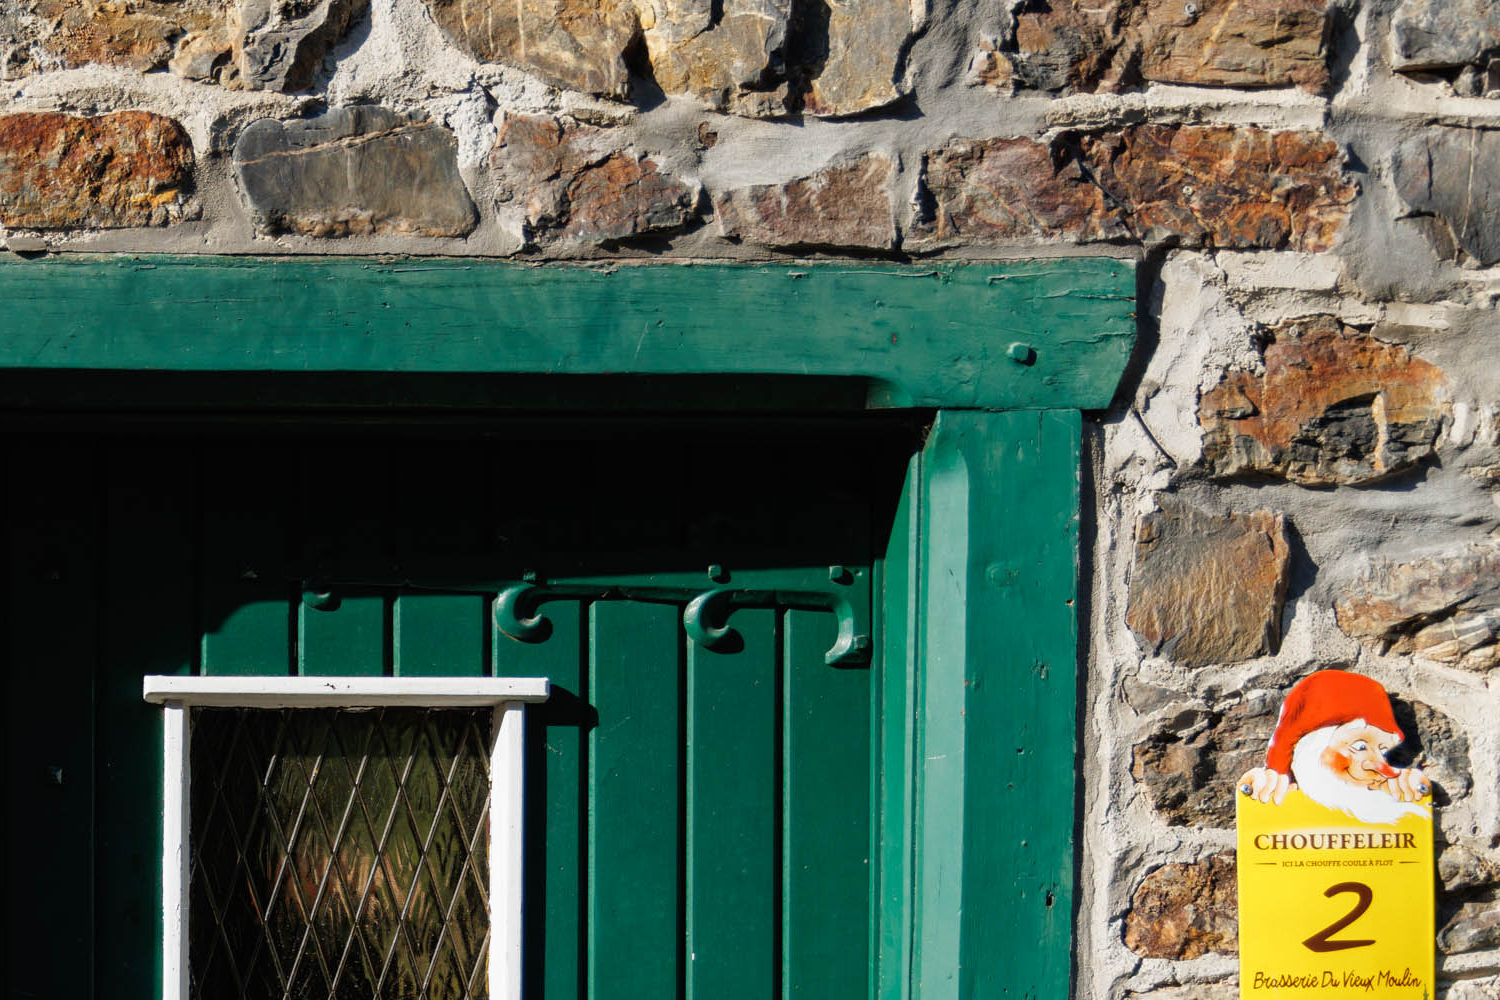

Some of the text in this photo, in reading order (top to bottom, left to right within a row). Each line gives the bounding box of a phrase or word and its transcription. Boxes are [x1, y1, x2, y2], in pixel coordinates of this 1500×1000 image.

[1253, 832, 1418, 851] CHOUFFELEIR
[1306, 860, 1341, 868] CHOUFFE
[1302, 881, 1376, 952] 2
[1253, 967, 1422, 992] Brasserie Du Vieux Moulin
